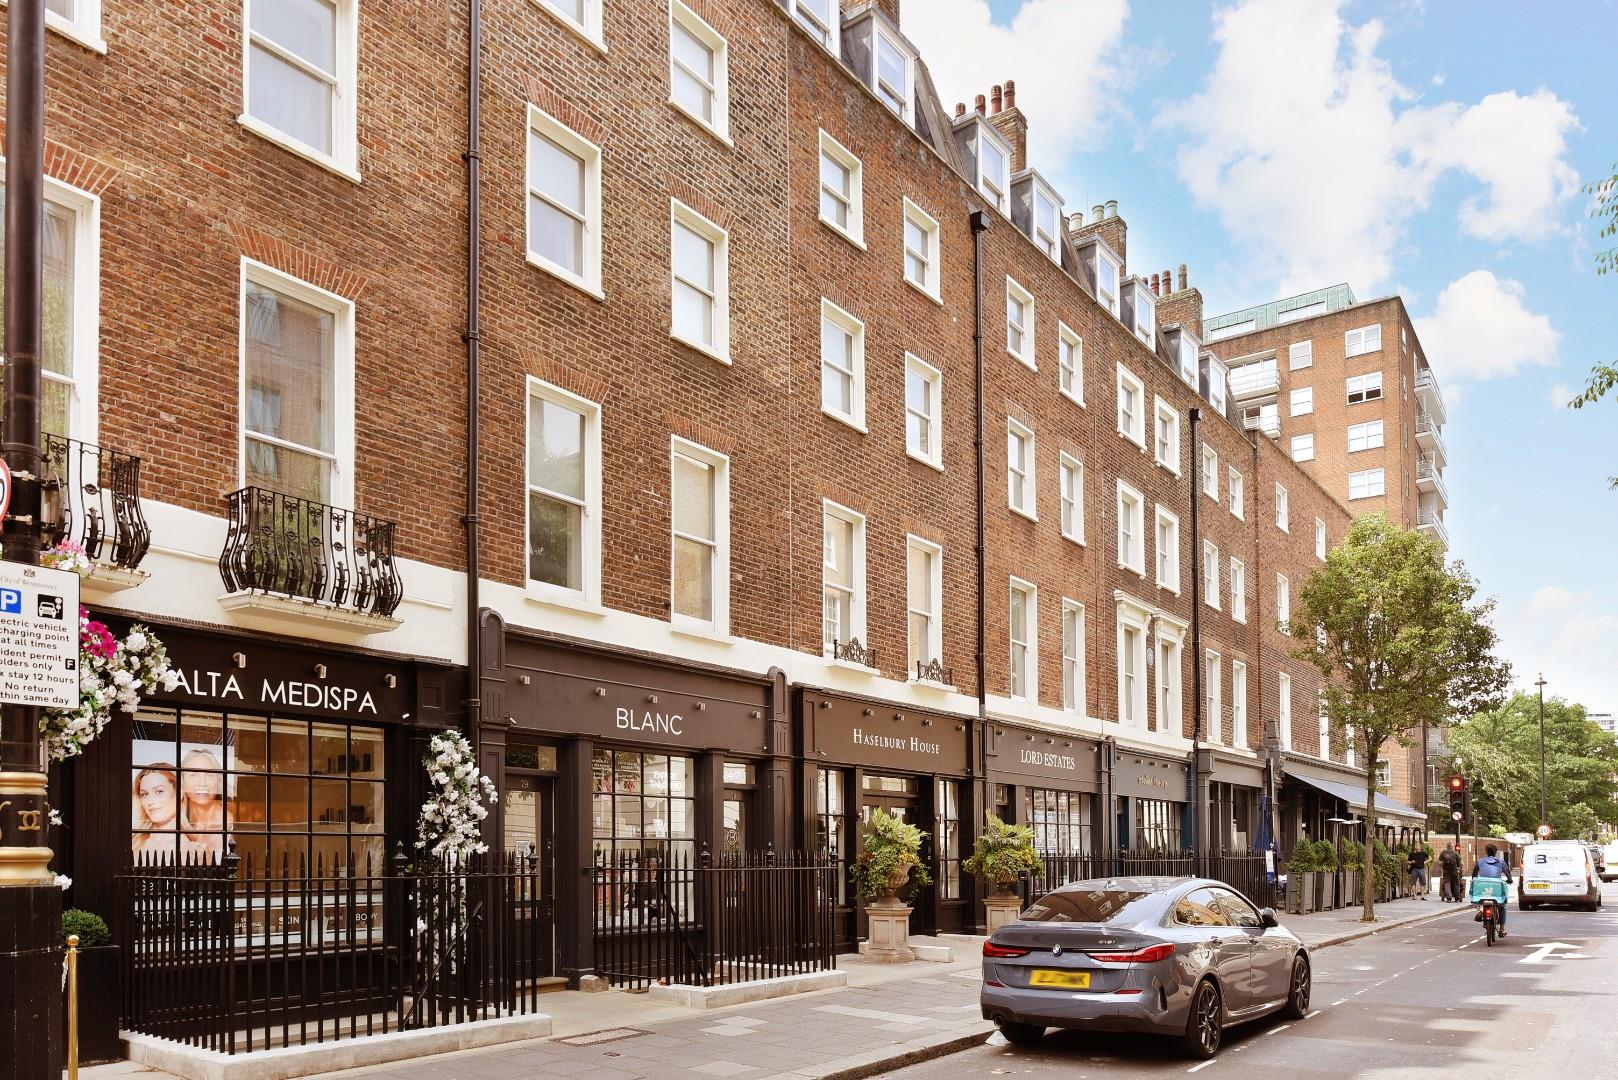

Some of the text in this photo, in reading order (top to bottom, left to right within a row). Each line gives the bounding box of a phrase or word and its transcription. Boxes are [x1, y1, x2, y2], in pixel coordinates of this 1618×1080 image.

[1, 590, 18, 610] P
[33, 623, 67, 632] vehicle
[45, 633, 69, 642] point
[15, 638, 26, 646] all
[31, 640, 57, 649] times
[30, 653, 62, 661] permit
[32, 662, 53, 671] only
[8, 671, 29, 680] stay
[47, 674, 74, 684] hours
[5, 682, 54, 693] No return
[23, 694, 49, 702] same
[52, 696, 69, 705] day
[261, 678, 378, 714] MEDISPA
[616, 707, 682, 735] BLANC
[1020, 749, 1075, 770] LORD ESTATES
[355, 912, 378, 922] BOY
